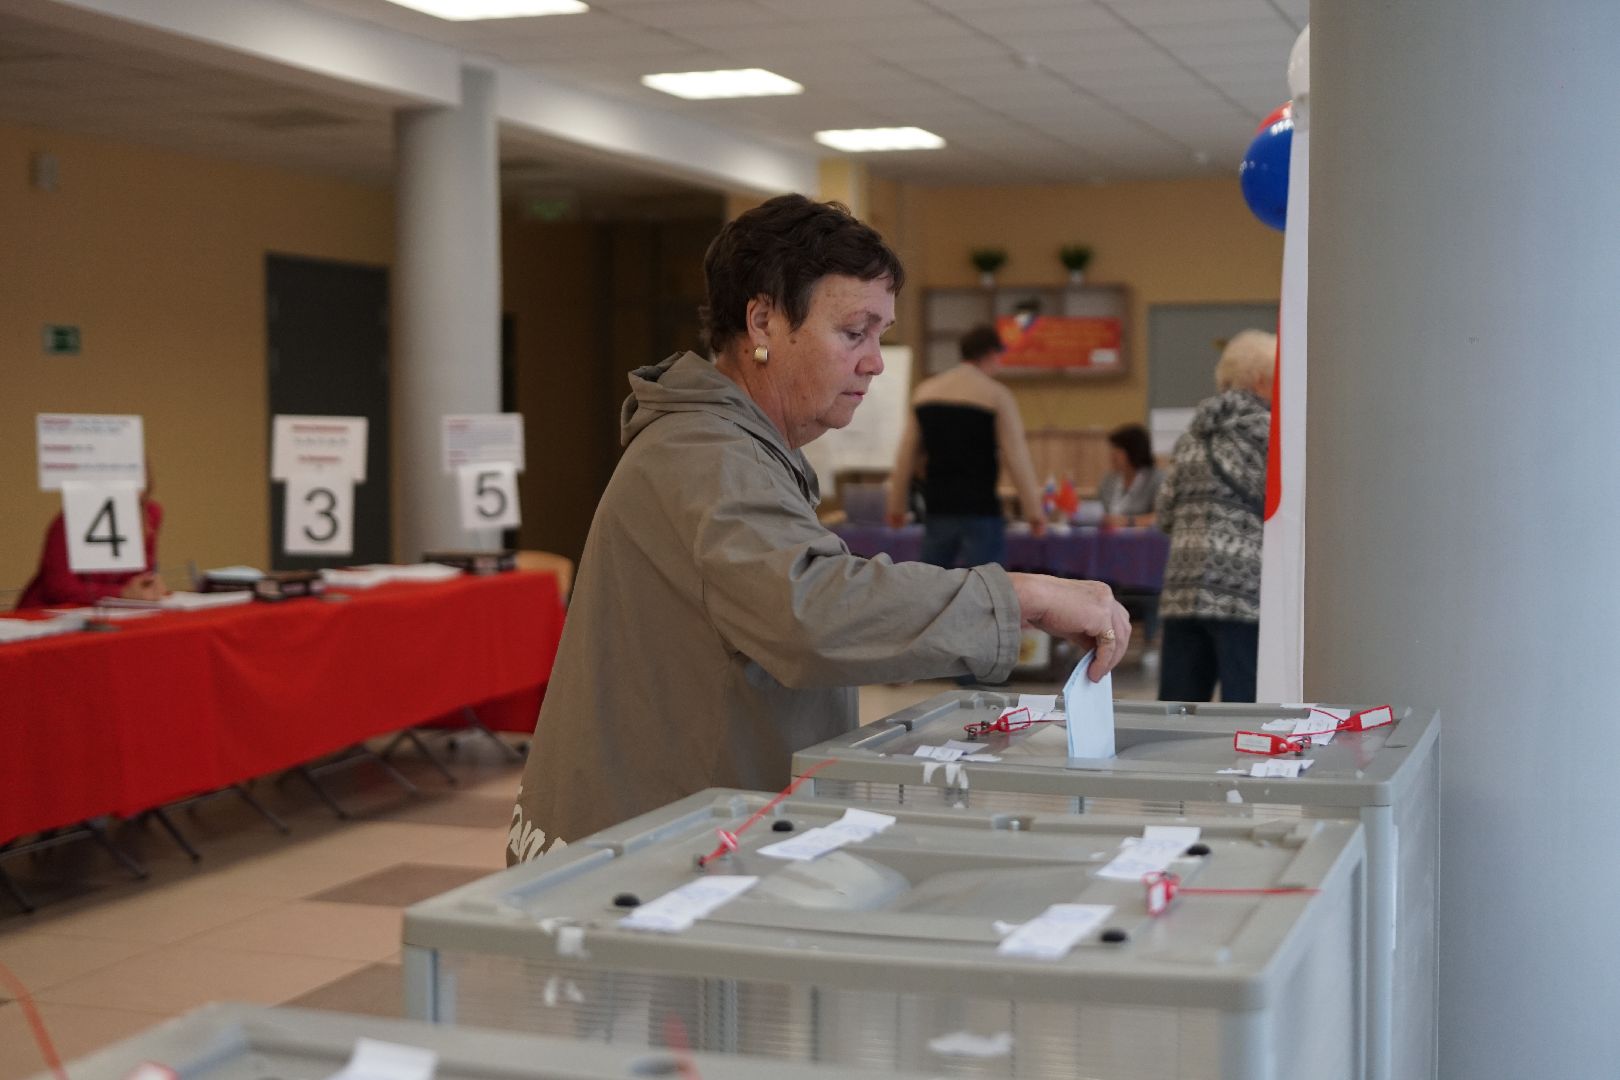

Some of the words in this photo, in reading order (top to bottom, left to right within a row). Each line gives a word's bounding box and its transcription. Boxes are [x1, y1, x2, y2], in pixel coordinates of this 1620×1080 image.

[304, 486, 339, 543] 3
[475, 471, 508, 519] 5
[84, 496, 128, 558] 4
